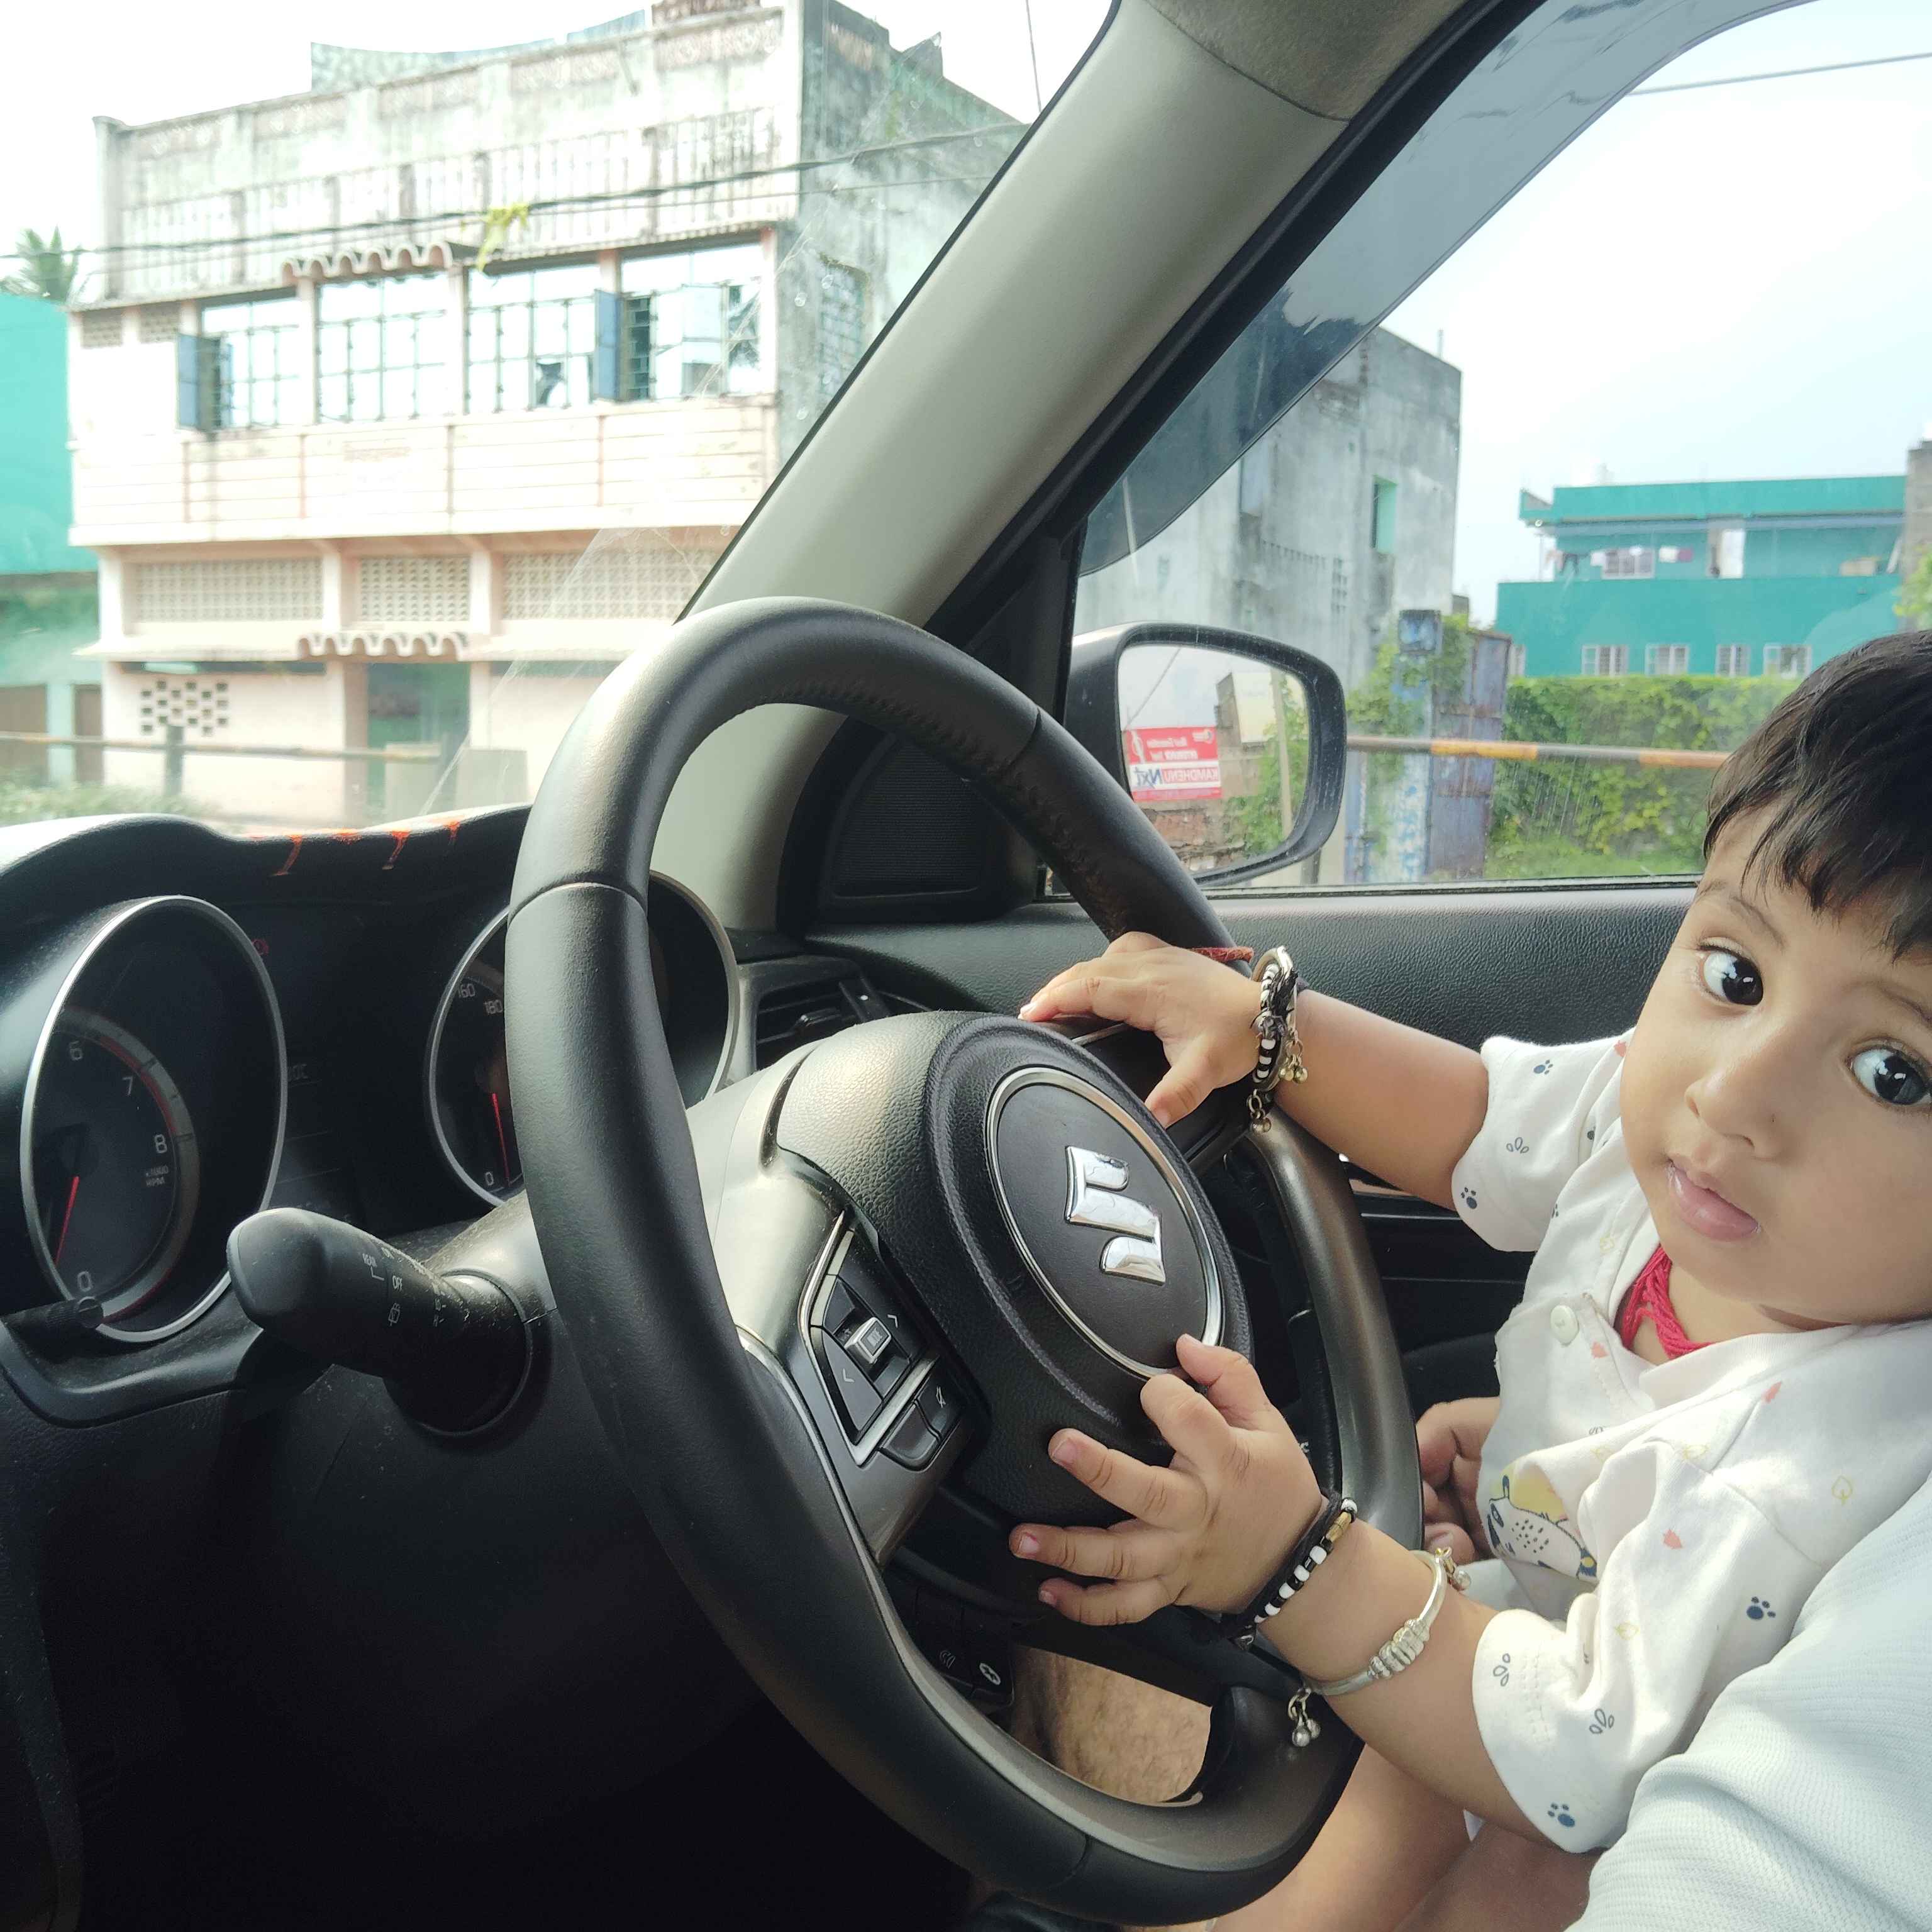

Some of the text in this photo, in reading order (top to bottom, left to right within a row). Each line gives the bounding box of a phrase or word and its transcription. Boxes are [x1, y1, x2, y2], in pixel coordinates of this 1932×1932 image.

[69, 1040, 83, 1062] 6
[121, 1076, 134, 1097] 7
[153, 1134, 168, 1155] 8
[485, 1172, 494, 1185] 0
[77, 1271, 91, 1292] 0
